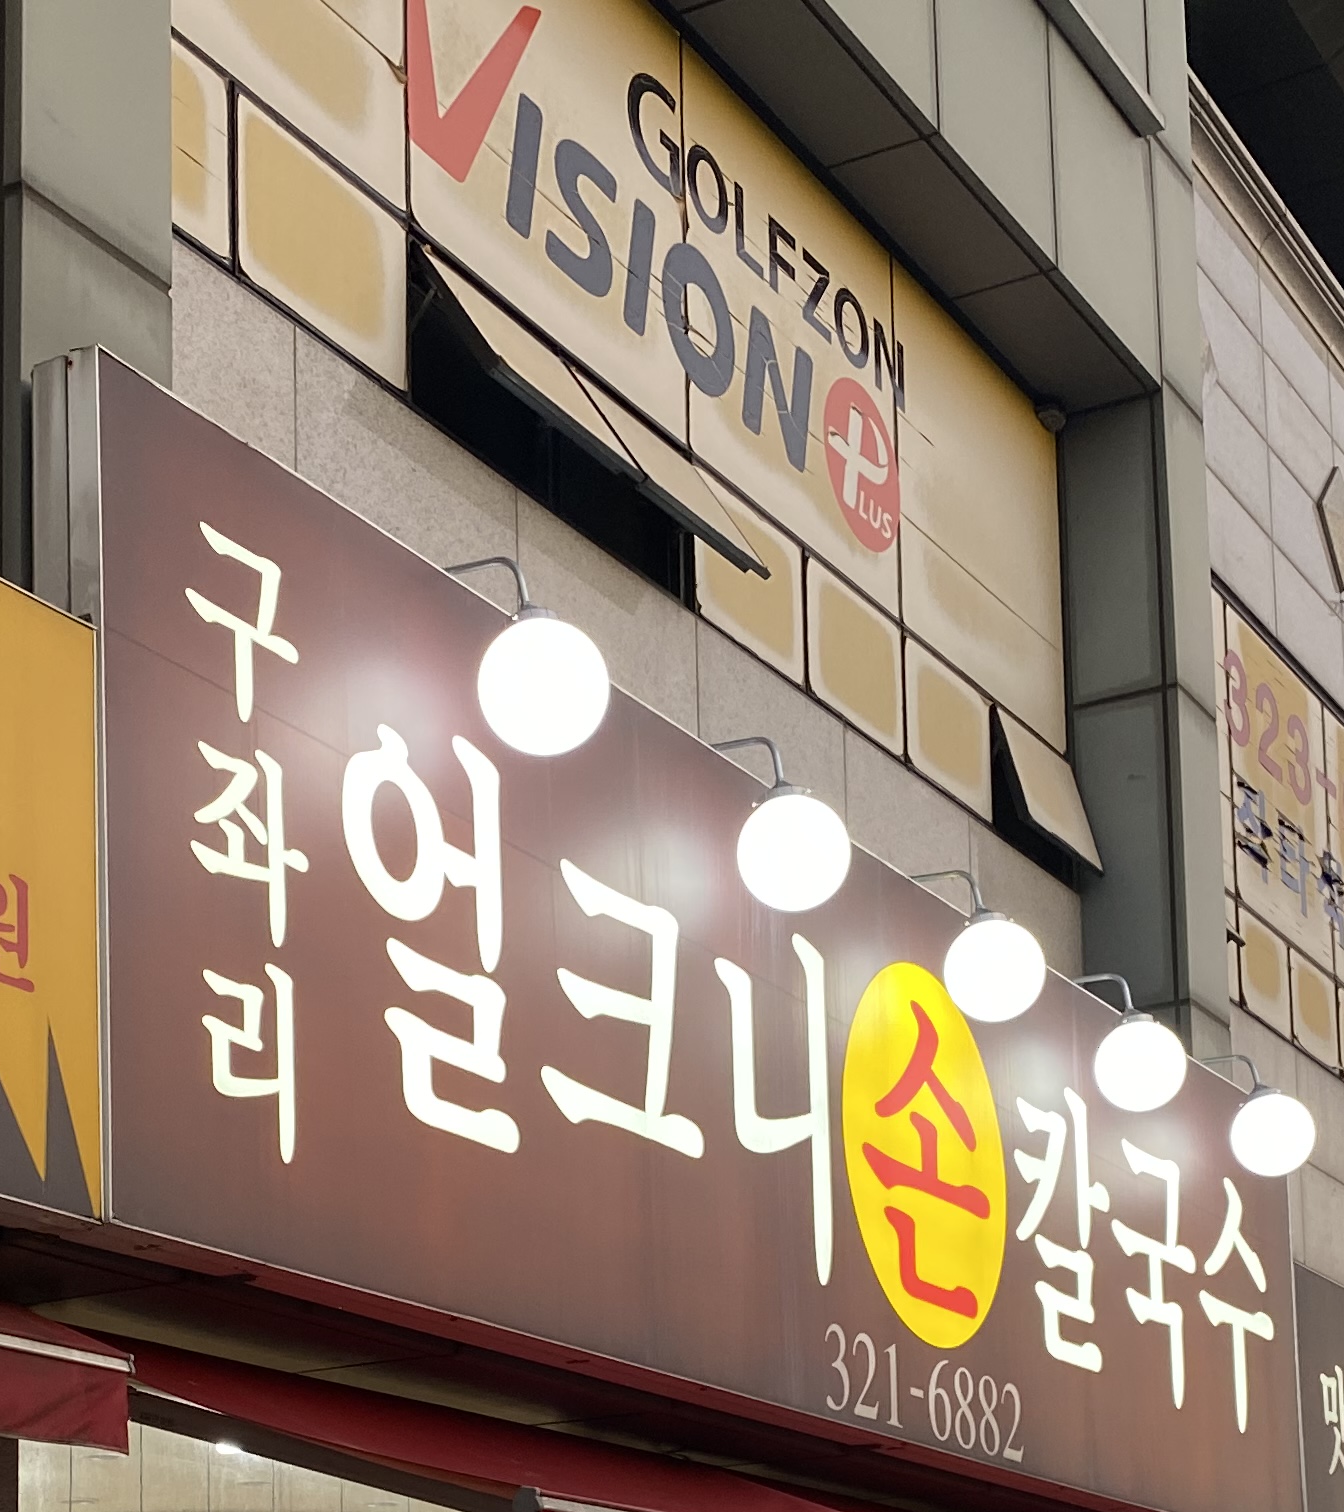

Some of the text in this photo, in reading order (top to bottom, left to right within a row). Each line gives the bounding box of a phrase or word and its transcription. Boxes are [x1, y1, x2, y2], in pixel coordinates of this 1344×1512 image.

[407, 0, 814, 472] VISION
[627, 72, 906, 413] GOLFZON
[185, 521, 309, 1164] 구좌리
[825, 1323, 1025, 1464] 321-6882
